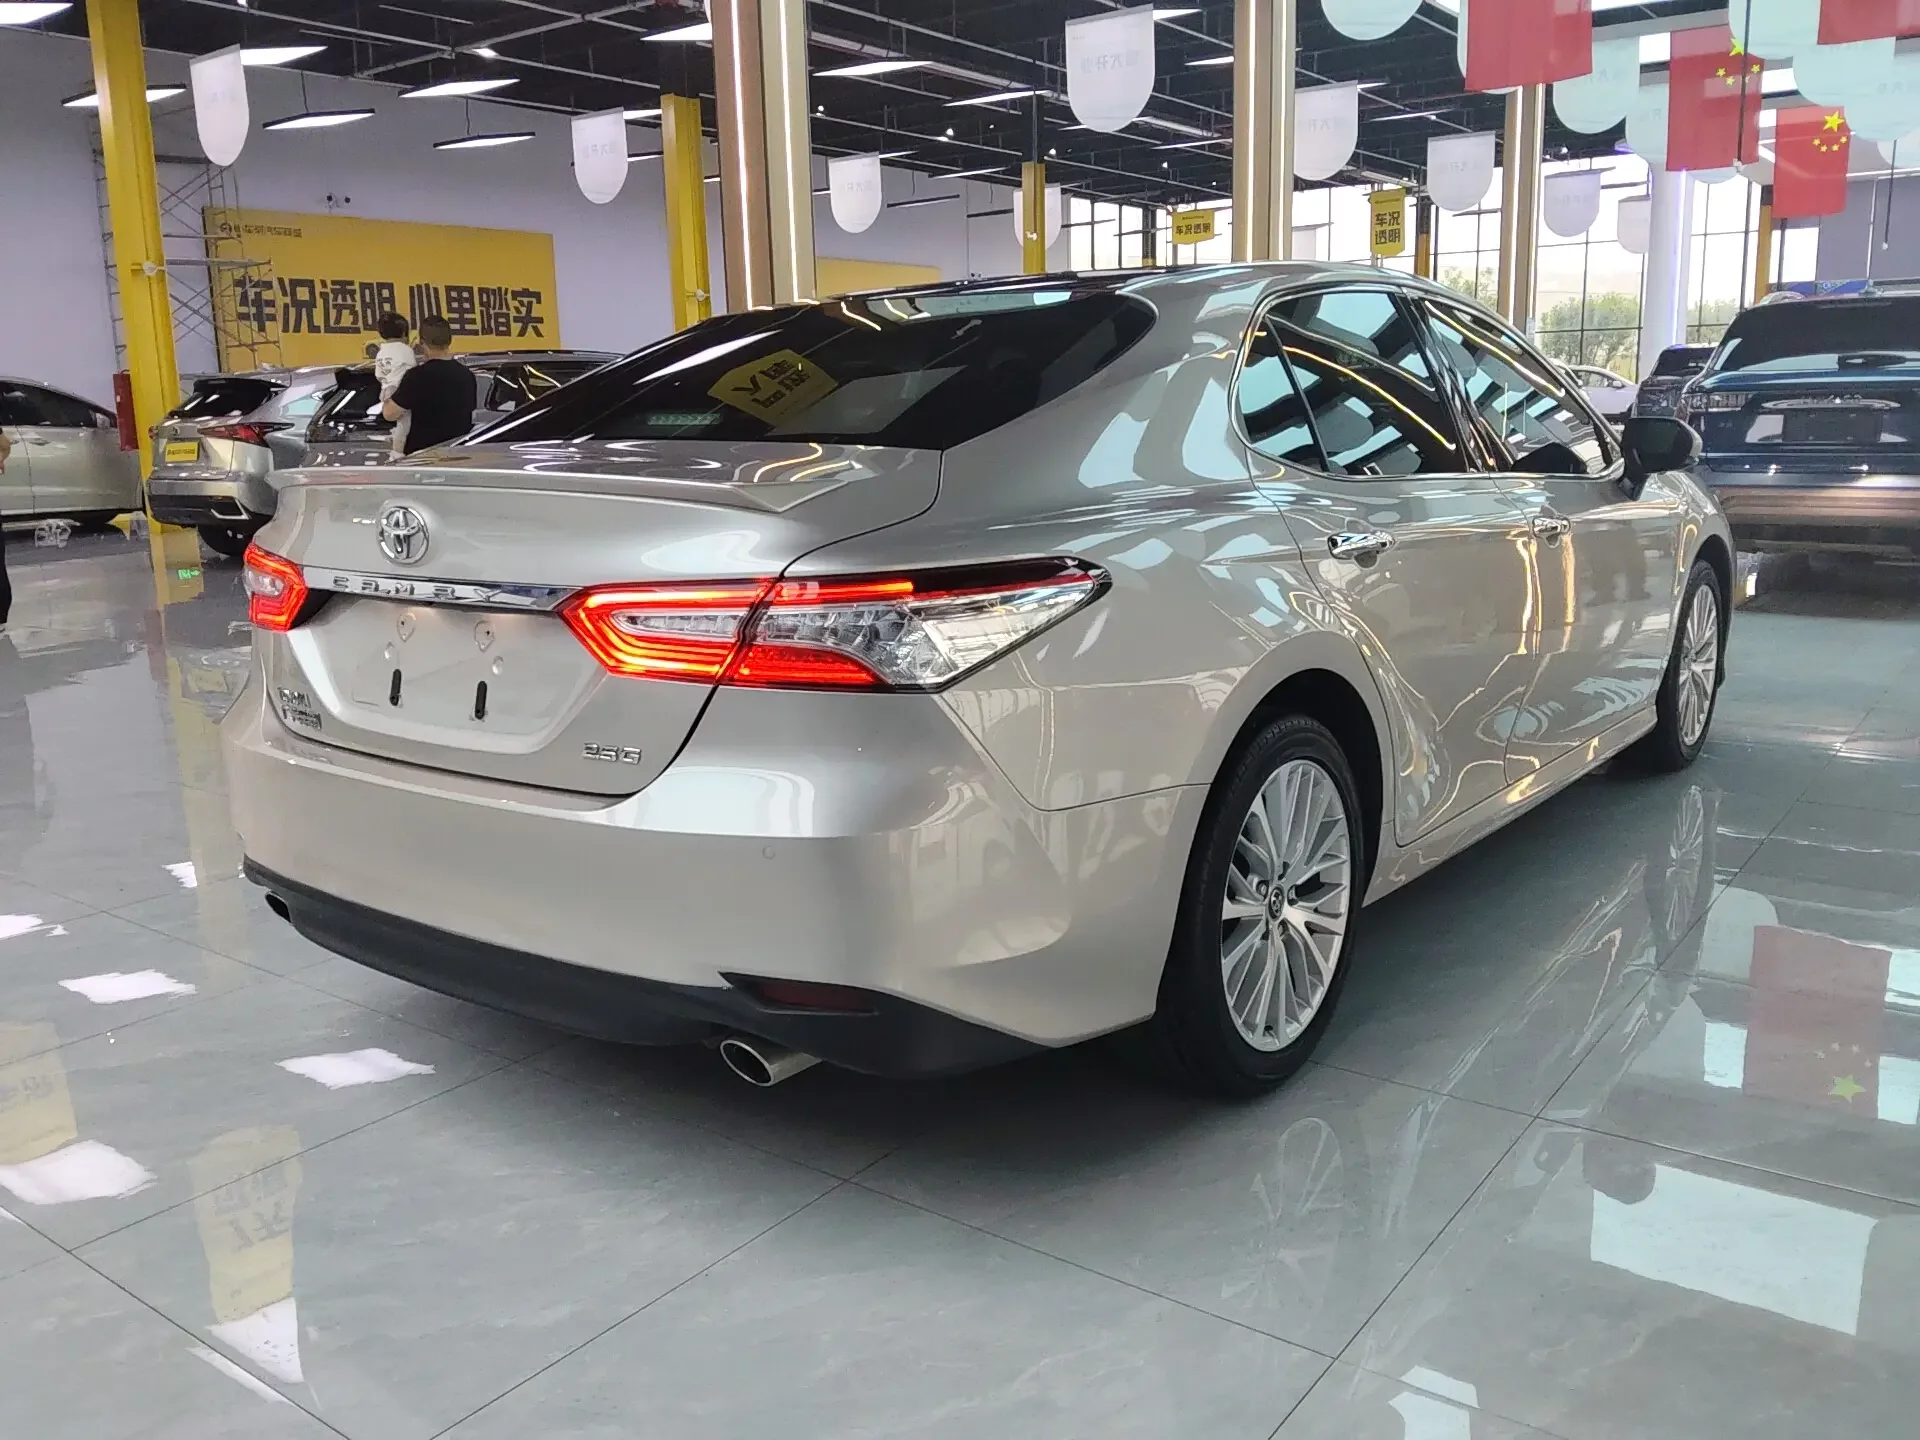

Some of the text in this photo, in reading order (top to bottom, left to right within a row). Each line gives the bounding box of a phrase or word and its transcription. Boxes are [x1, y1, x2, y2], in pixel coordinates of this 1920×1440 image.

[1375, 210, 1401, 227] 车况
[1175, 222, 1211, 236] 车况透明
[1375, 228, 1401, 245] 透明
[235, 277, 545, 339] 车况透明 心里踏实
